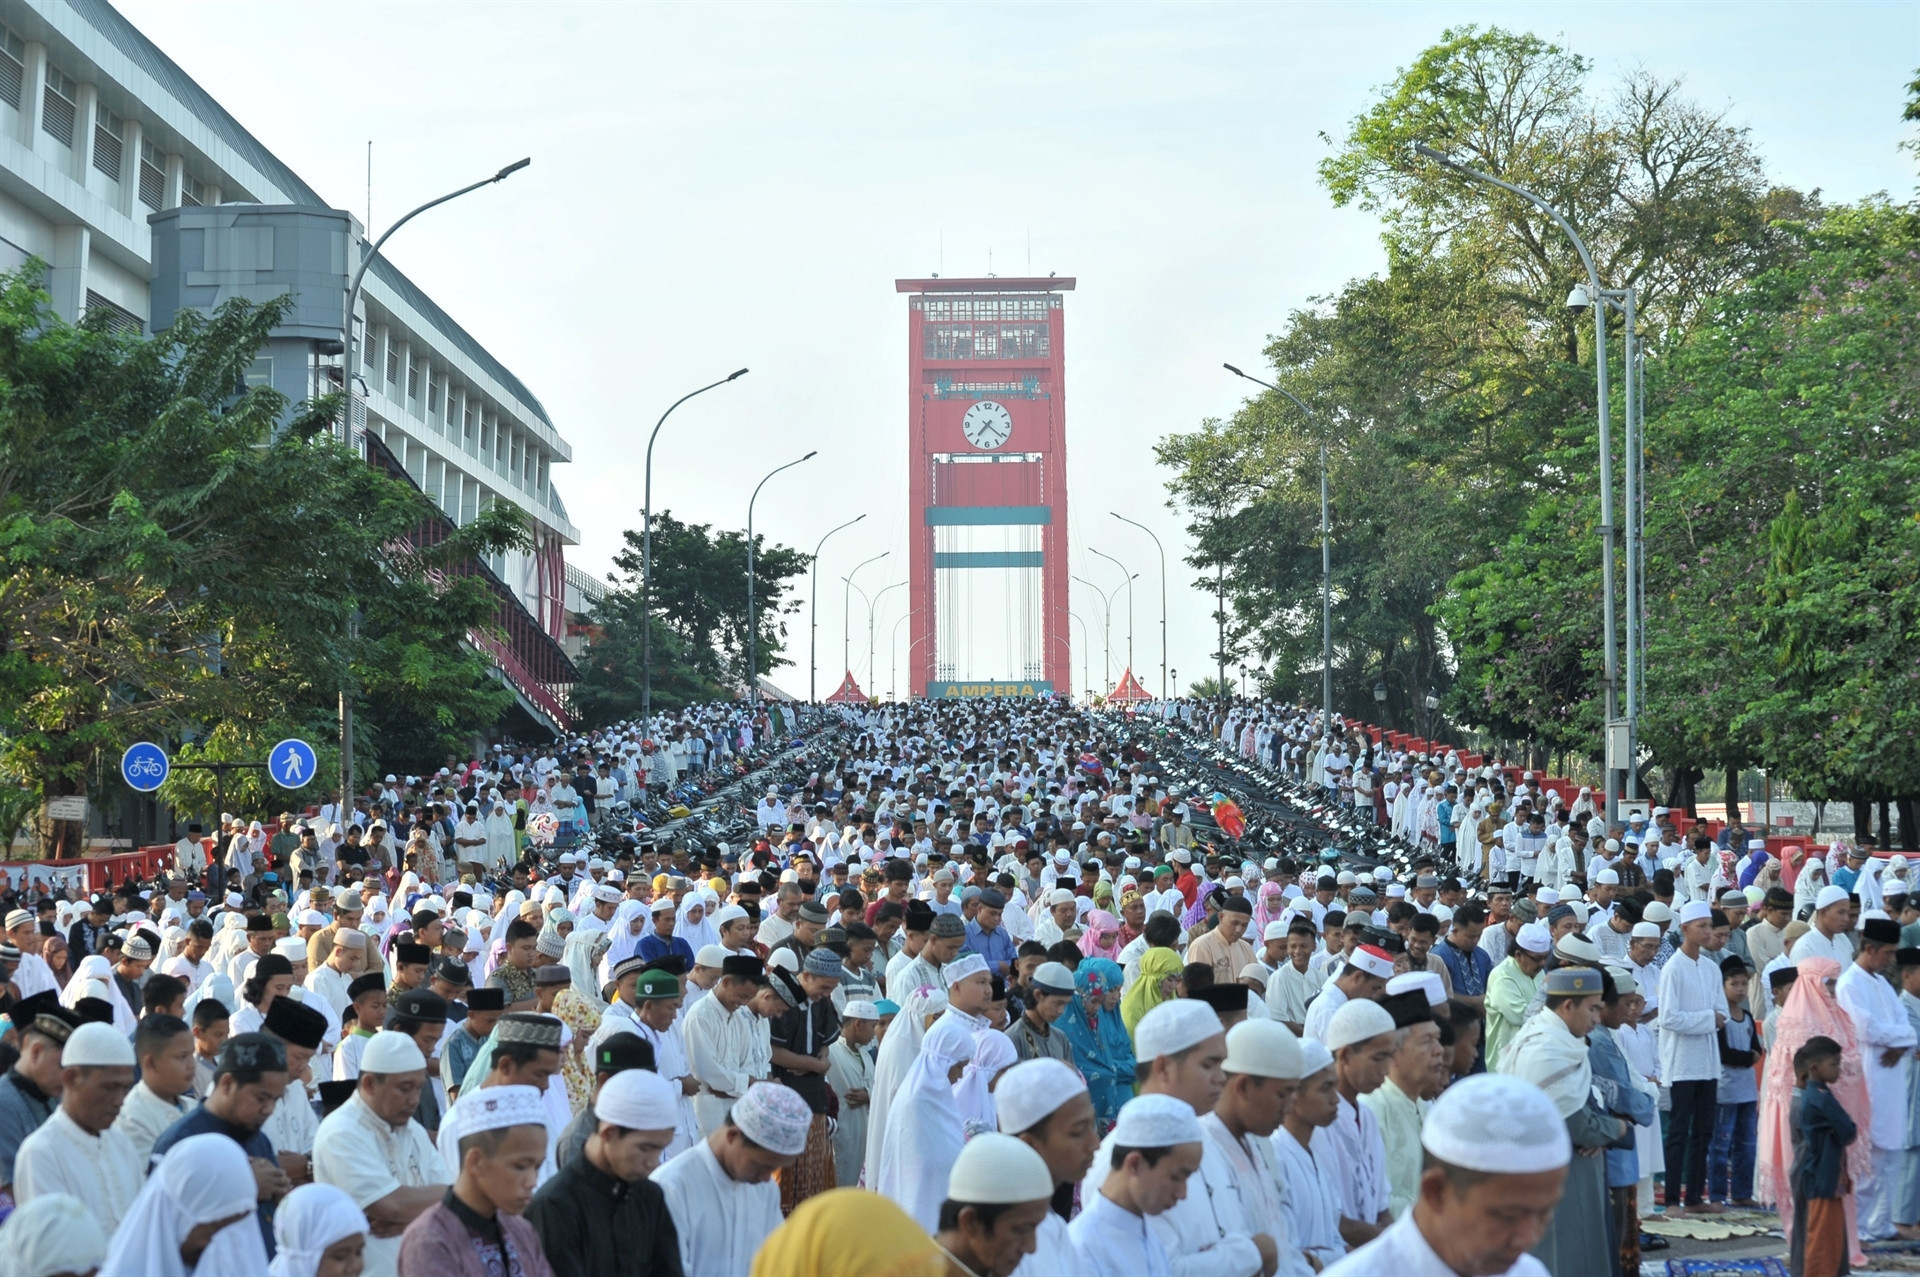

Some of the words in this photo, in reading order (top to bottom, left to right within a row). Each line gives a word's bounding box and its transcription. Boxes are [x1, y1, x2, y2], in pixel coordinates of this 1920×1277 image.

[964, 421, 970, 429] 9
[1004, 421, 1010, 429] 3
[945, 685, 1034, 696] AMPERA
